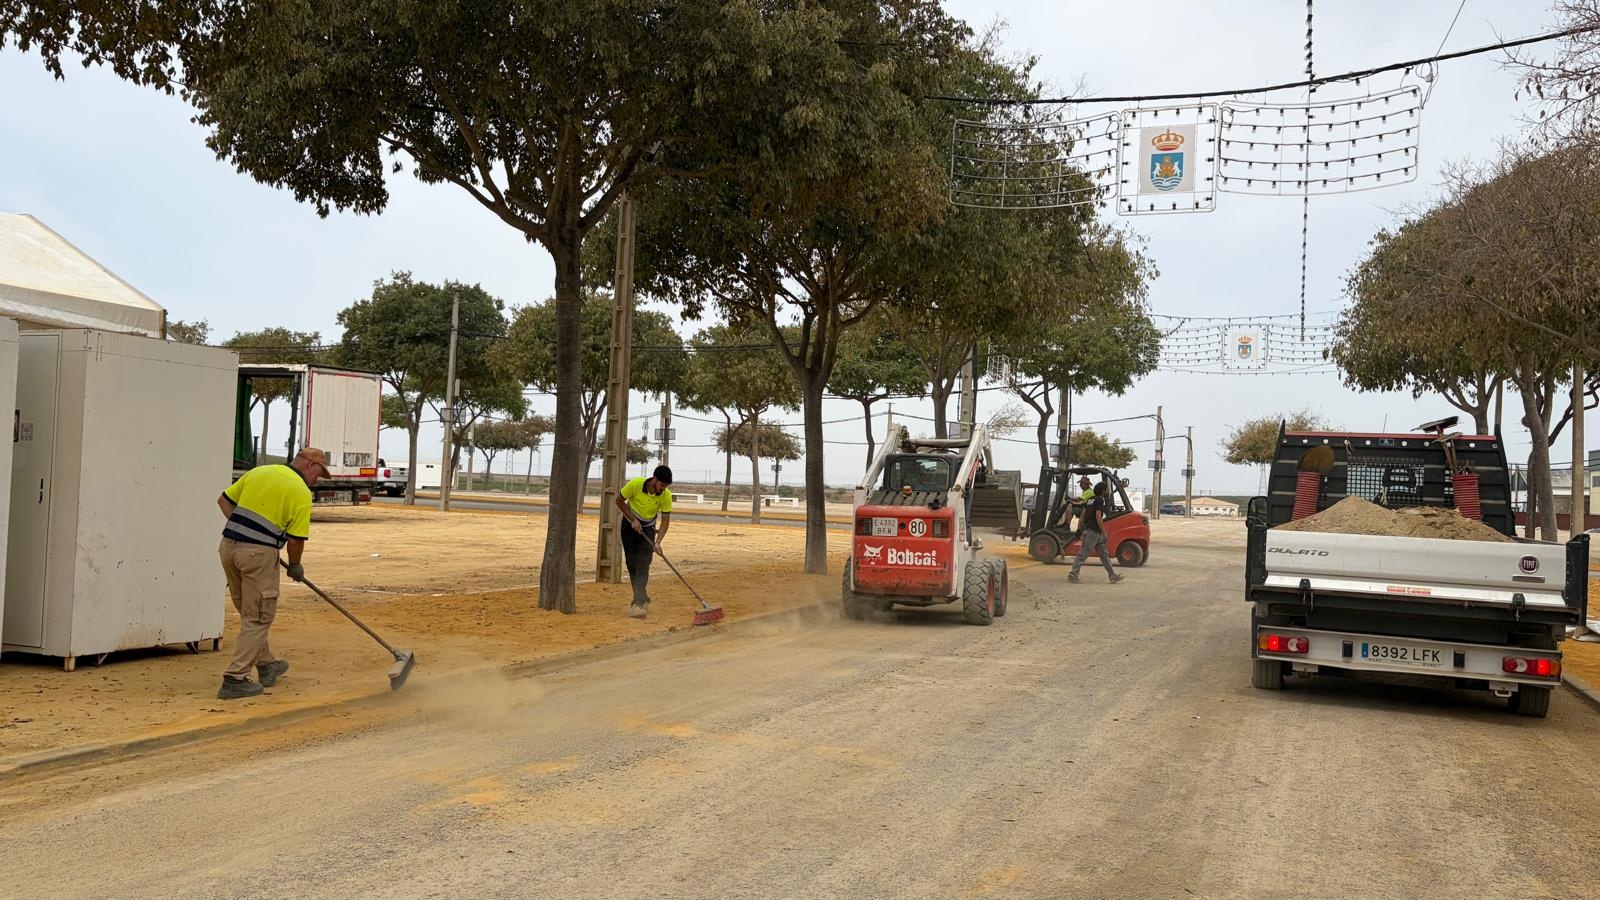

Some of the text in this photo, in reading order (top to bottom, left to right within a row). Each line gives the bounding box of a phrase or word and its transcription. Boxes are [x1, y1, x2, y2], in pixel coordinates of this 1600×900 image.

[910, 521, 925, 534] 80
[887, 548, 937, 567] Bobcat
[1523, 559, 1536, 569] FIAT
[1371, 645, 1408, 660] 8392
[1412, 648, 1440, 662] LFK
